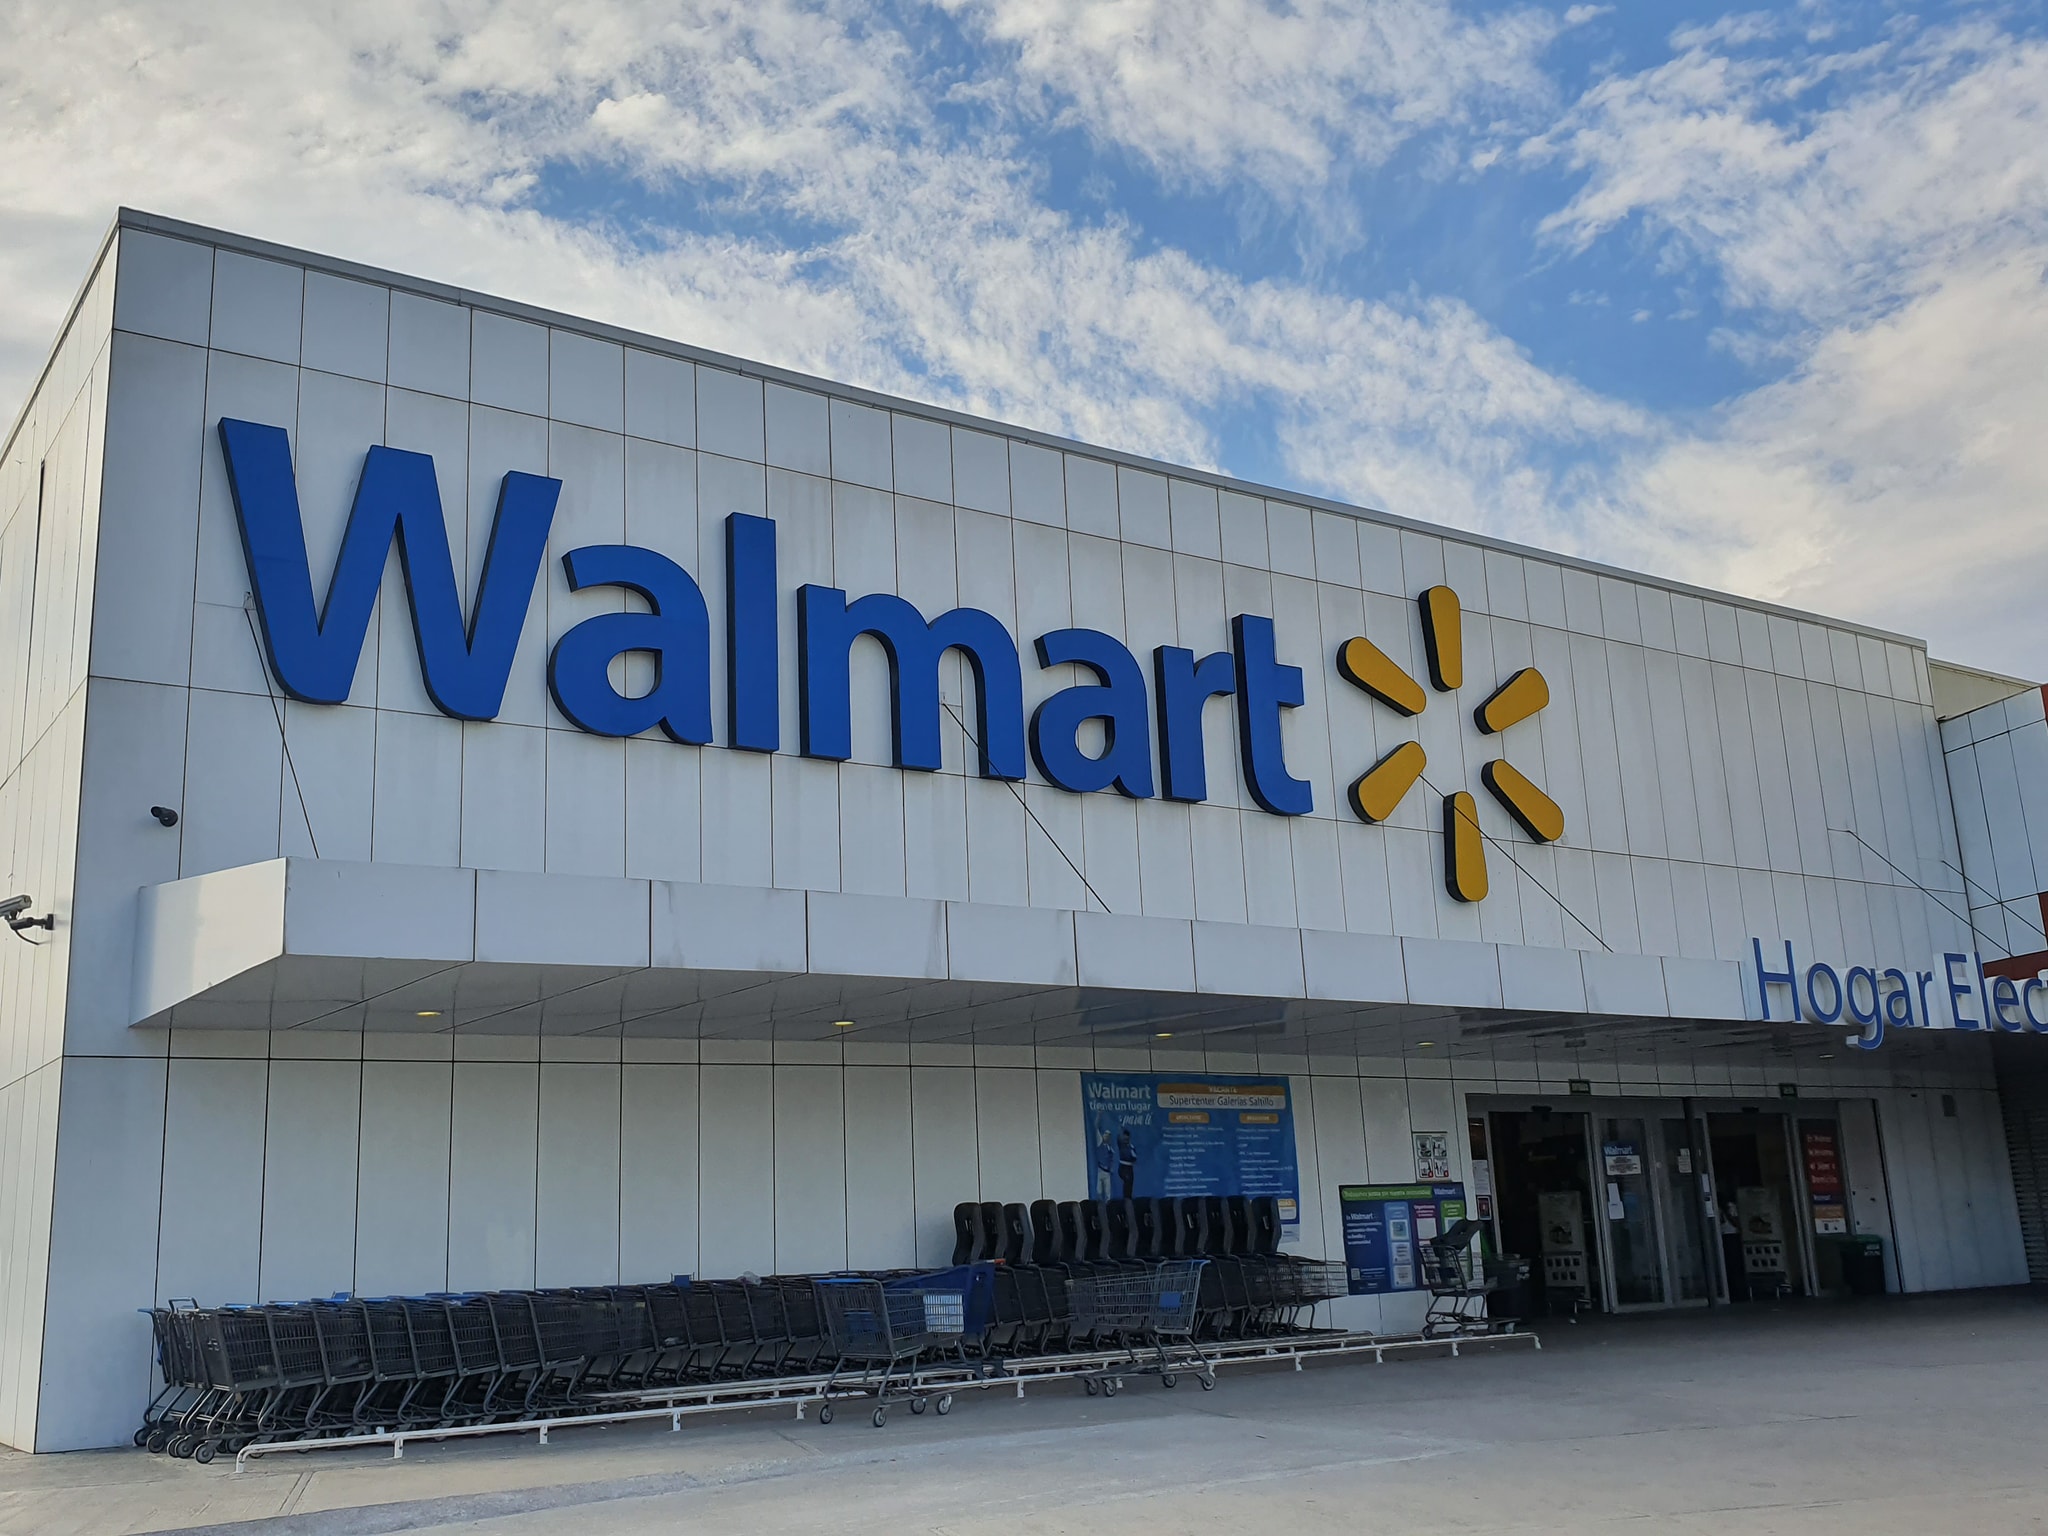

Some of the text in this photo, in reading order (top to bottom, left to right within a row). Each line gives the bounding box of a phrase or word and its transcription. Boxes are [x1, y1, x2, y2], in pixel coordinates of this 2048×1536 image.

[218, 417, 1313, 816] Walmart
[1753, 937, 2048, 1050] Hogar Elec
[1088, 1082, 1151, 1099] Walmart
[1089, 1100, 1151, 1113] tiene un lugar
[1169, 1095, 1215, 1107] Supercenter
[1249, 1096, 1274, 1107] Saltillo
[1604, 1145, 1633, 1155] Walmart
